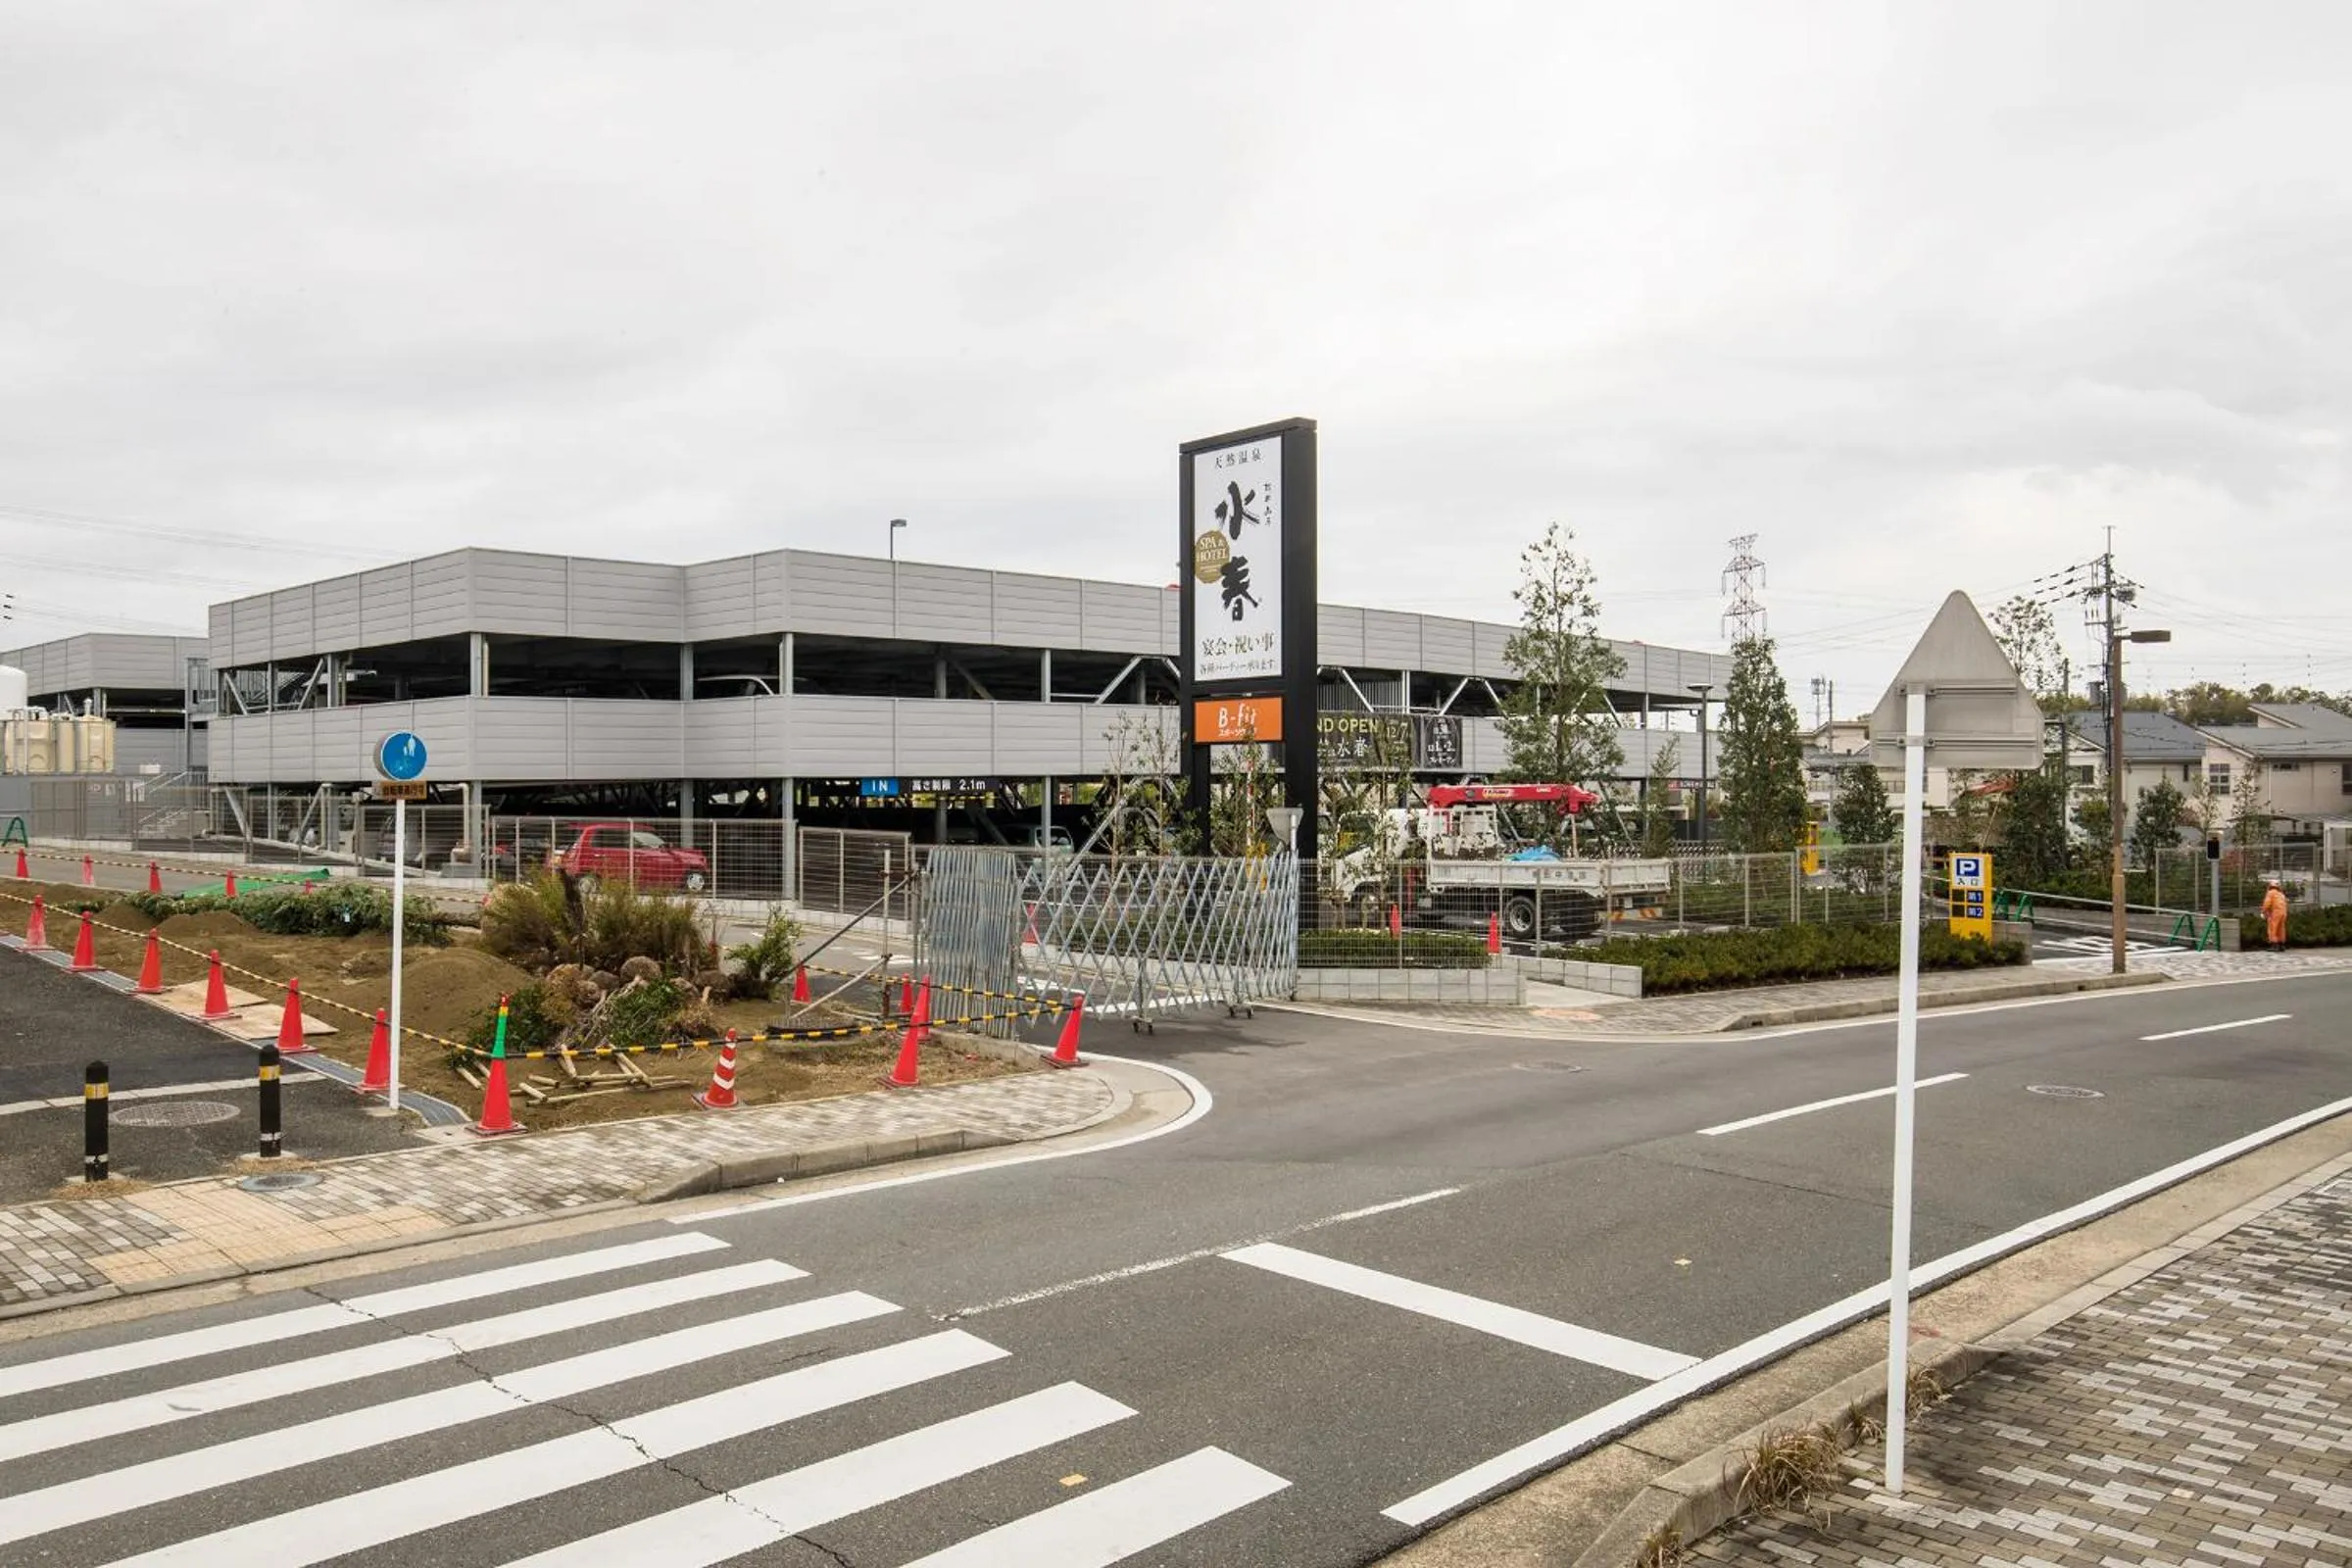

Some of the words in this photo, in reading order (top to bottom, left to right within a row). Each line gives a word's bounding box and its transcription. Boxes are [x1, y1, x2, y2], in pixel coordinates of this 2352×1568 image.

[1215, 448, 1261, 469] 天然温泉
[1200, 536, 1216, 550] SPA
[1214, 480, 1260, 621] 水春
[1200, 548, 1228, 562] HOTEL
[1338, 717, 1378, 733] OPEN
[872, 779, 888, 792] IN
[911, 779, 952, 792] 高さ制限
[958, 778, 986, 791] 2.1m
[1959, 859, 1977, 875] P
